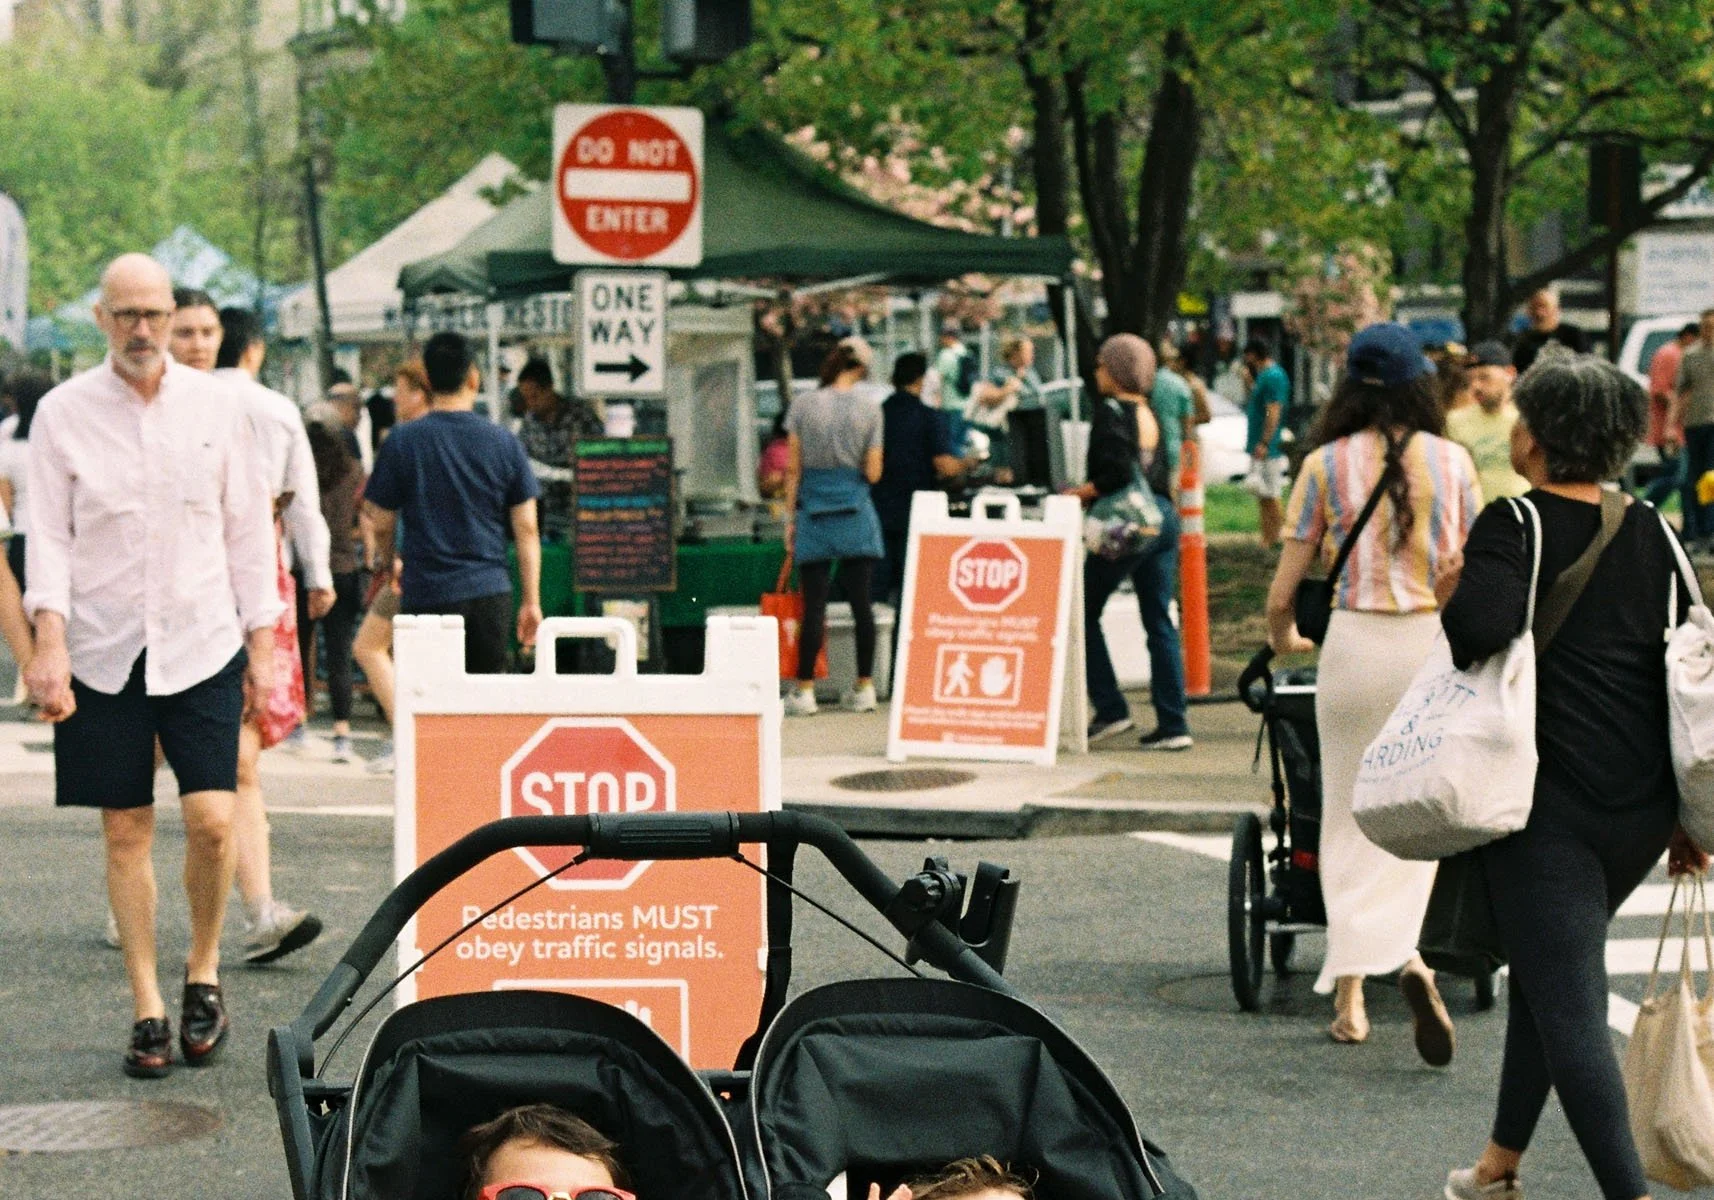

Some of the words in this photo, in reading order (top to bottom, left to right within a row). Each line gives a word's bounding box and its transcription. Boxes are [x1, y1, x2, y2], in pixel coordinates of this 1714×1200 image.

[577, 136, 615, 165] DO
[628, 138, 679, 166] NOT
[586, 204, 669, 234] ENTER
[592, 283, 653, 312] ONE
[590, 318, 655, 345] WAY
[958, 558, 1019, 589] STOP
[521, 771, 656, 816] STOP
[462, 904, 623, 930] Pedestrians
[632, 904, 719, 930] MUST
[455, 935, 524, 966] obey
[532, 934, 616, 960] traffic
[625, 934, 724, 966] signals.
